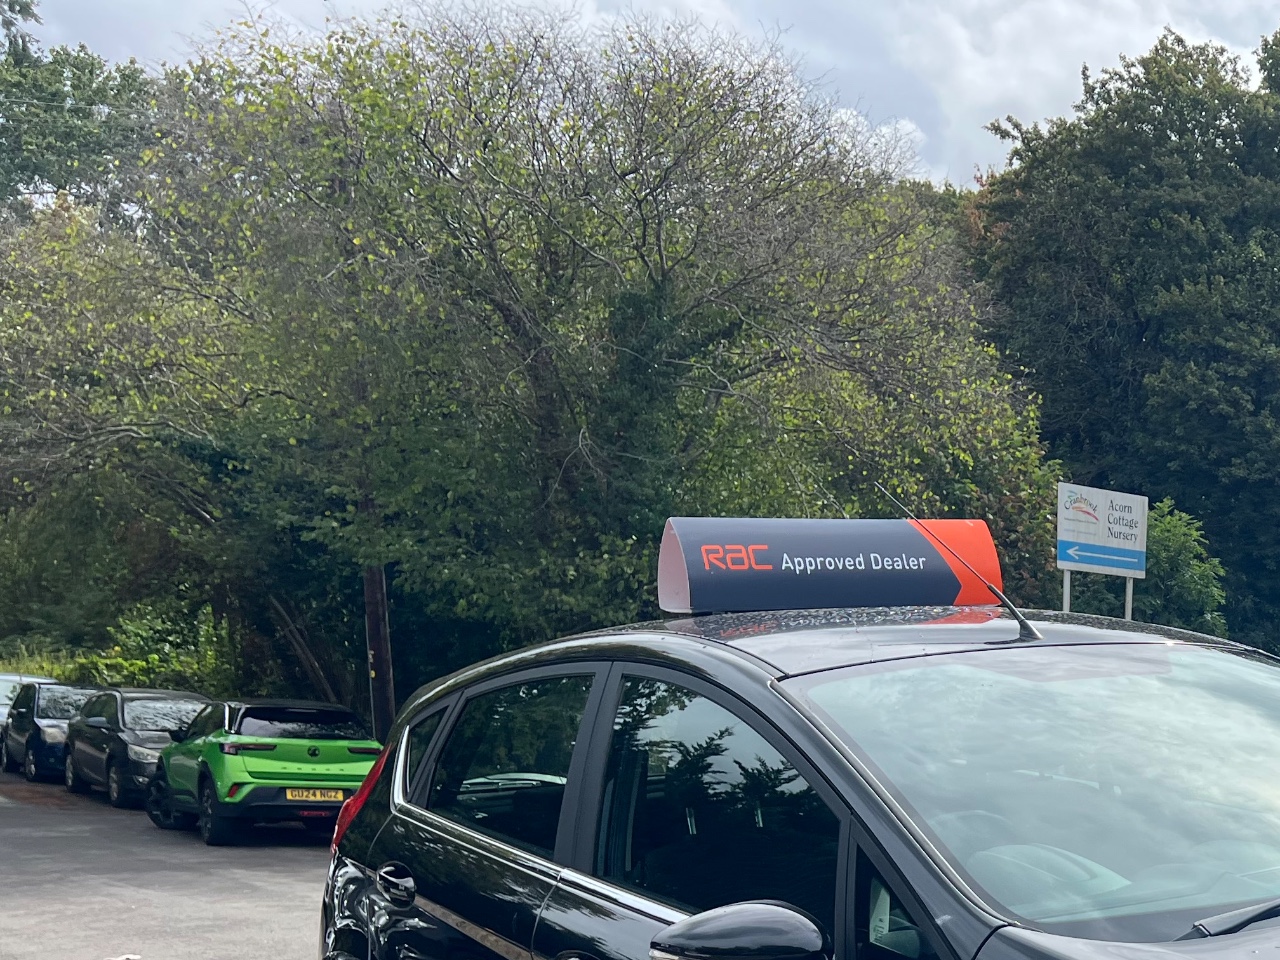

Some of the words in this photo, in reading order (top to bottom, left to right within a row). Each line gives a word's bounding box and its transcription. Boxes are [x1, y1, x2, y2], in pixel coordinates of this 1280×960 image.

[1108, 499, 1133, 514] Acorn
[1107, 513, 1139, 530] Cottage
[1107, 526, 1138, 543] Nursery
[781, 553, 865, 574] Approved
[870, 553, 926, 570] Dealer
[290, 790, 317, 799] GU24
